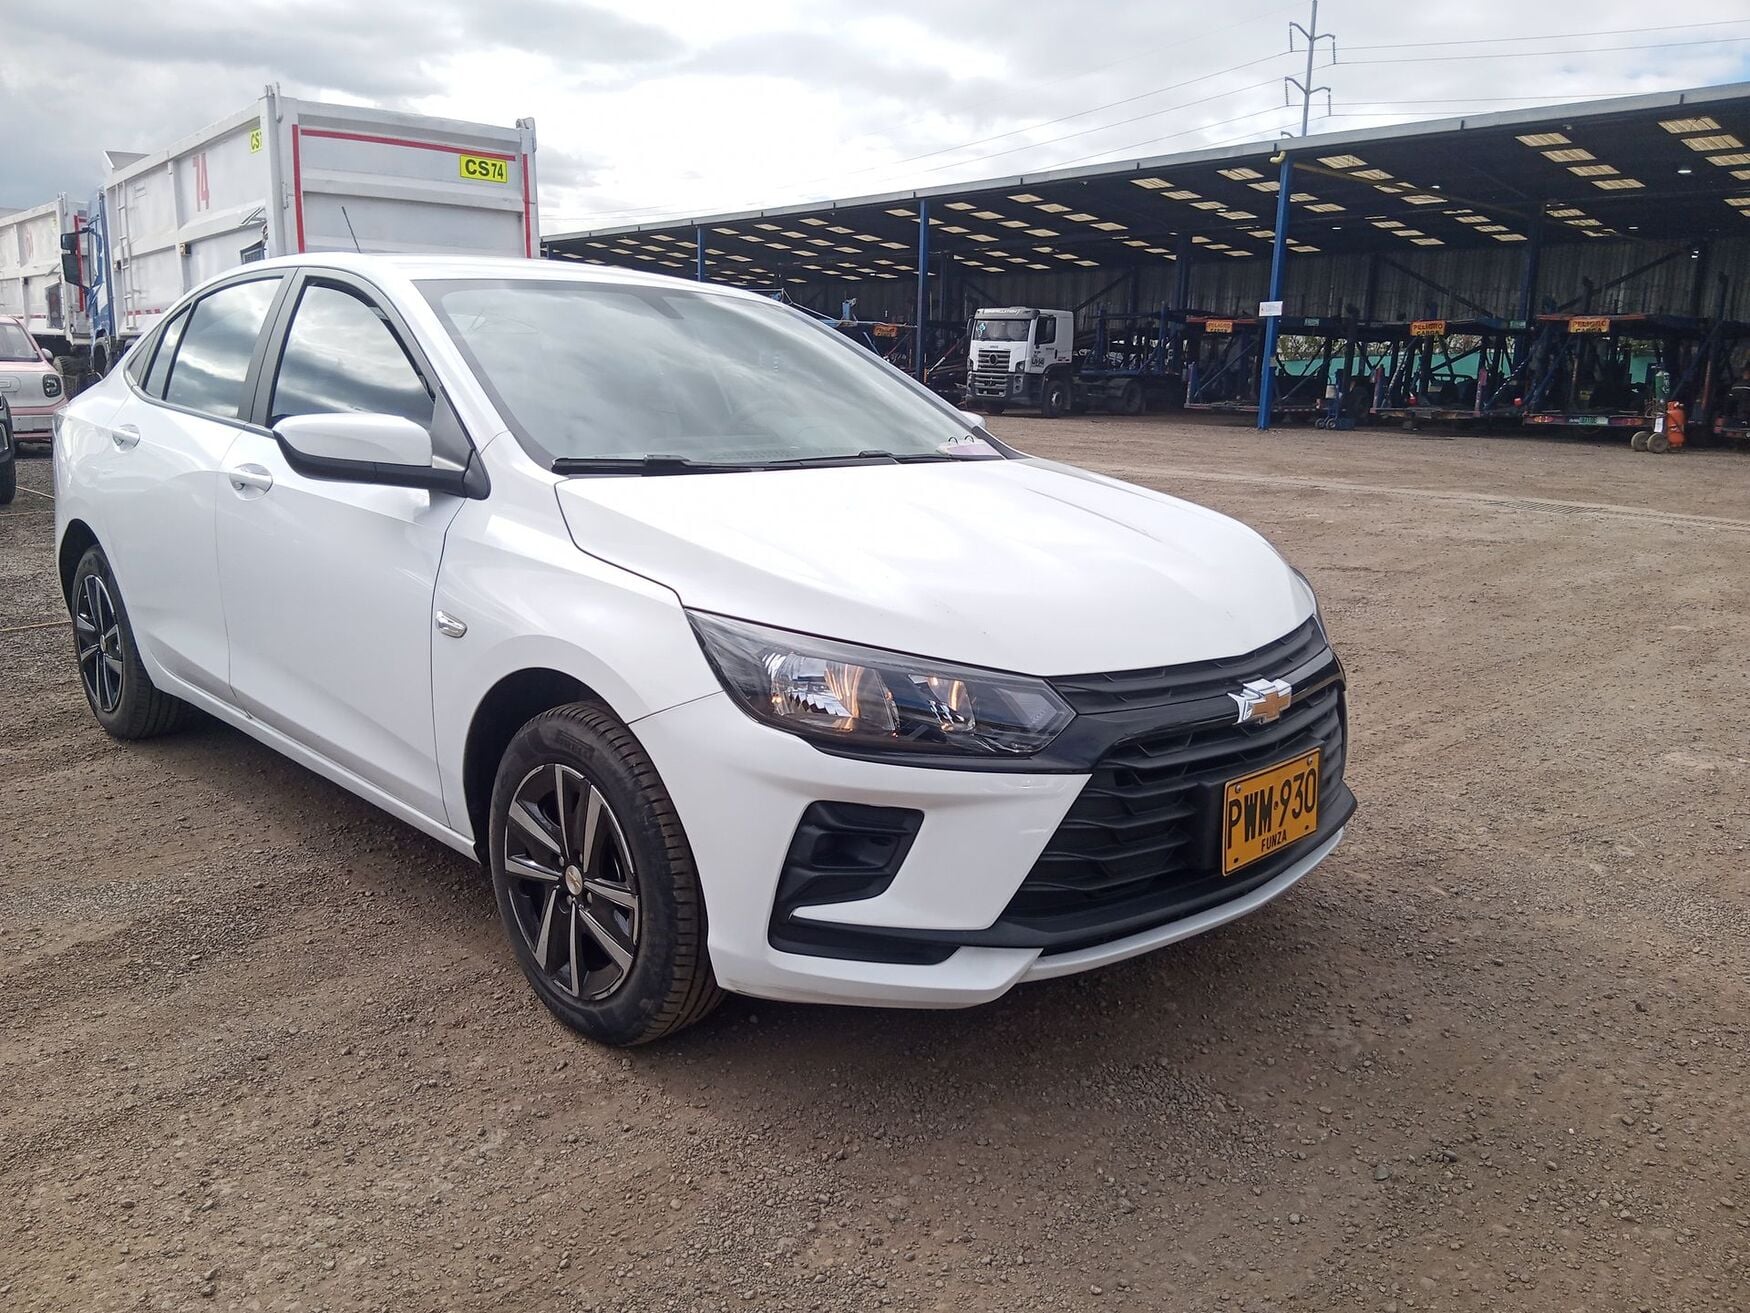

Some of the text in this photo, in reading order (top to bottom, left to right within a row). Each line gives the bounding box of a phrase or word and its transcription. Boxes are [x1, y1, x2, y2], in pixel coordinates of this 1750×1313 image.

[465, 159, 504, 180] CS74
[192, 152, 210, 212] 74
[1413, 322, 1443, 330] PELIGRO
[1261, 830, 1287, 851] FUNZA
